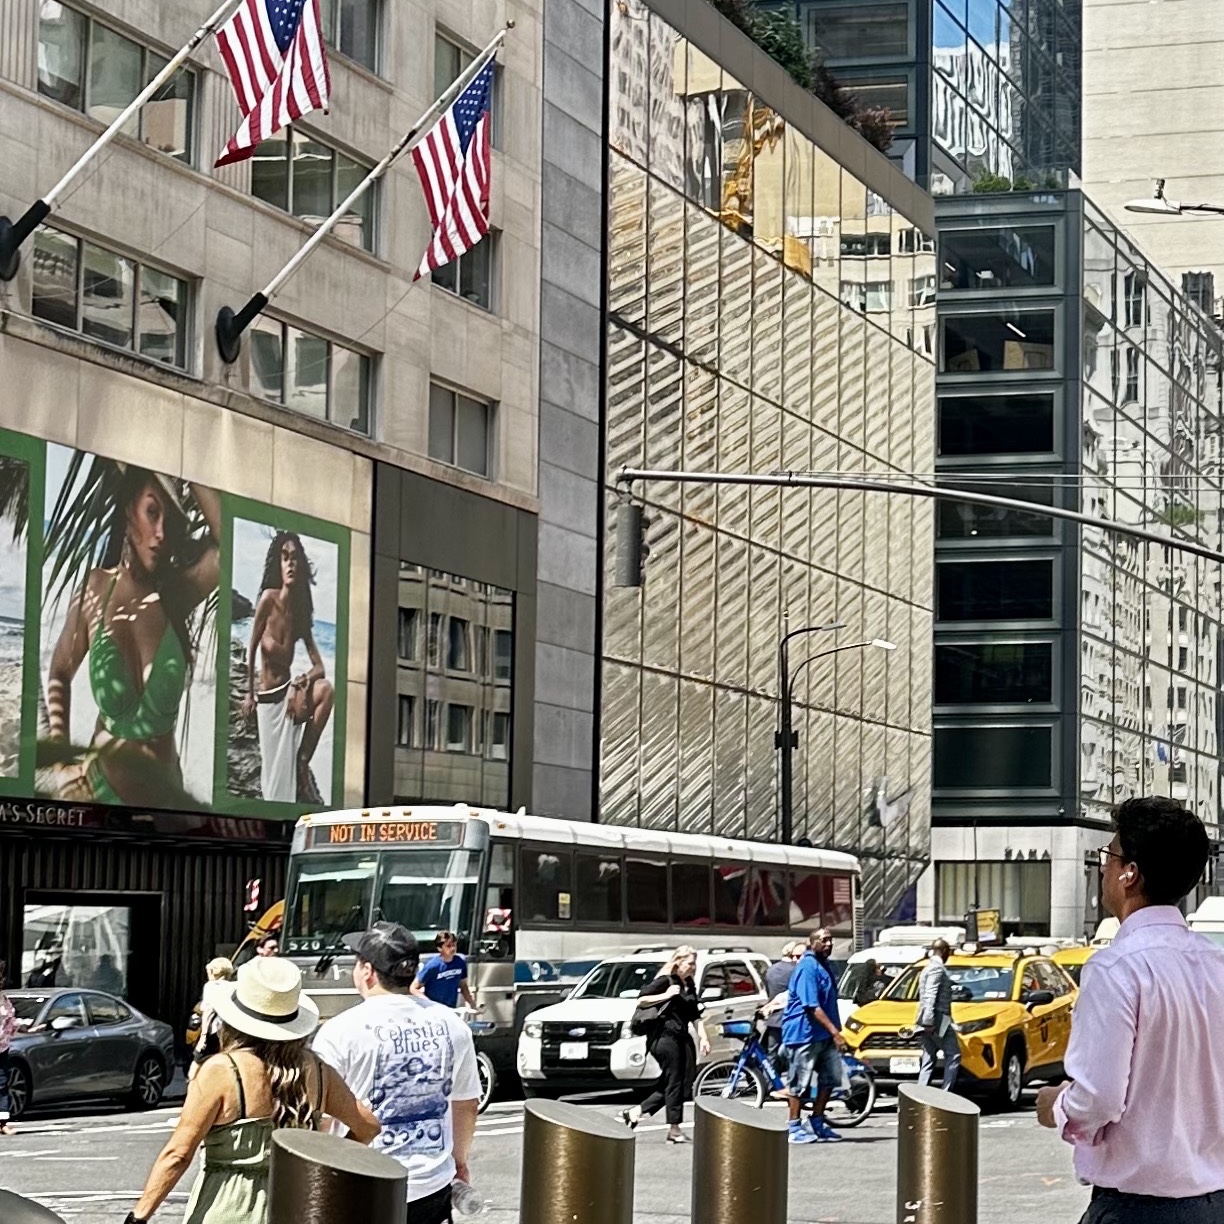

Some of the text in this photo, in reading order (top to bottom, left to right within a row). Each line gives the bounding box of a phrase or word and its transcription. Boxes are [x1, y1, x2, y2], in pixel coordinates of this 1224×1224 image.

[26, 804, 86, 826] SECRET
[330, 822, 438, 843] NOT IN SERVICE
[374, 1019, 450, 1041] Celestial
[394, 1037, 441, 1054] Blues
